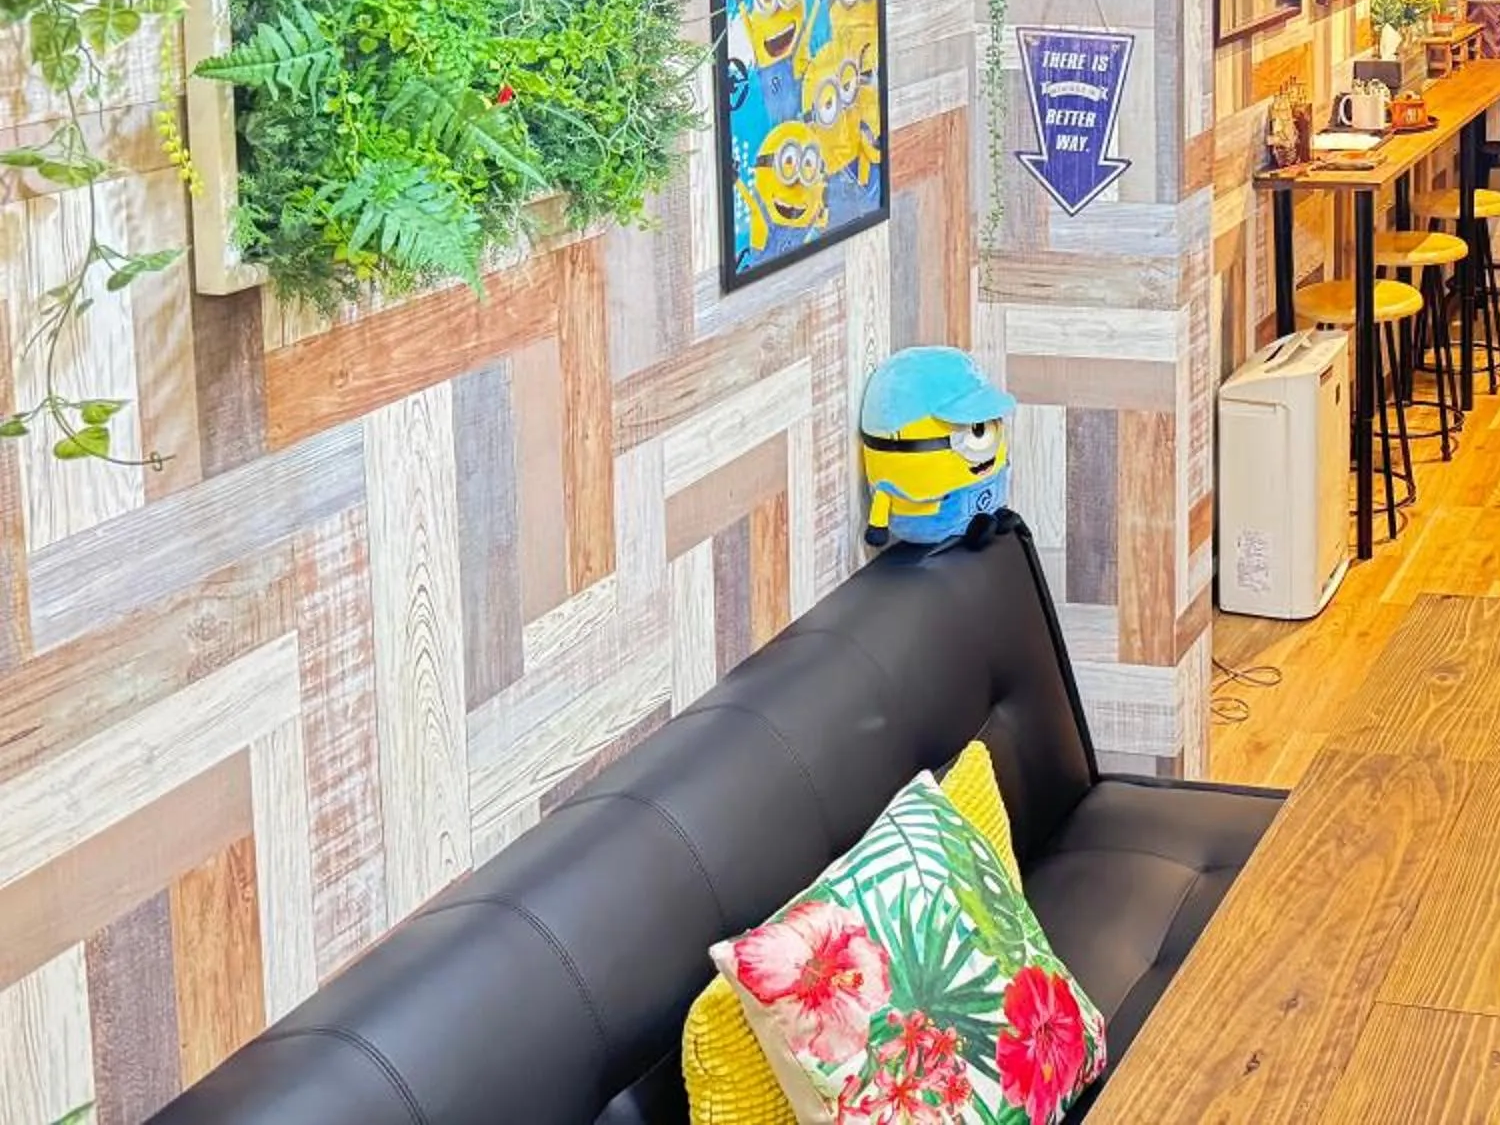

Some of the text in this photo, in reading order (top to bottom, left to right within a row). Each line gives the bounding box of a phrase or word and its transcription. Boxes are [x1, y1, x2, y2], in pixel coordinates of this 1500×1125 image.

[1042, 50, 1110, 72] THERE IS
[1045, 108, 1097, 128] BETTER
[1055, 134, 1092, 153] WAY.
